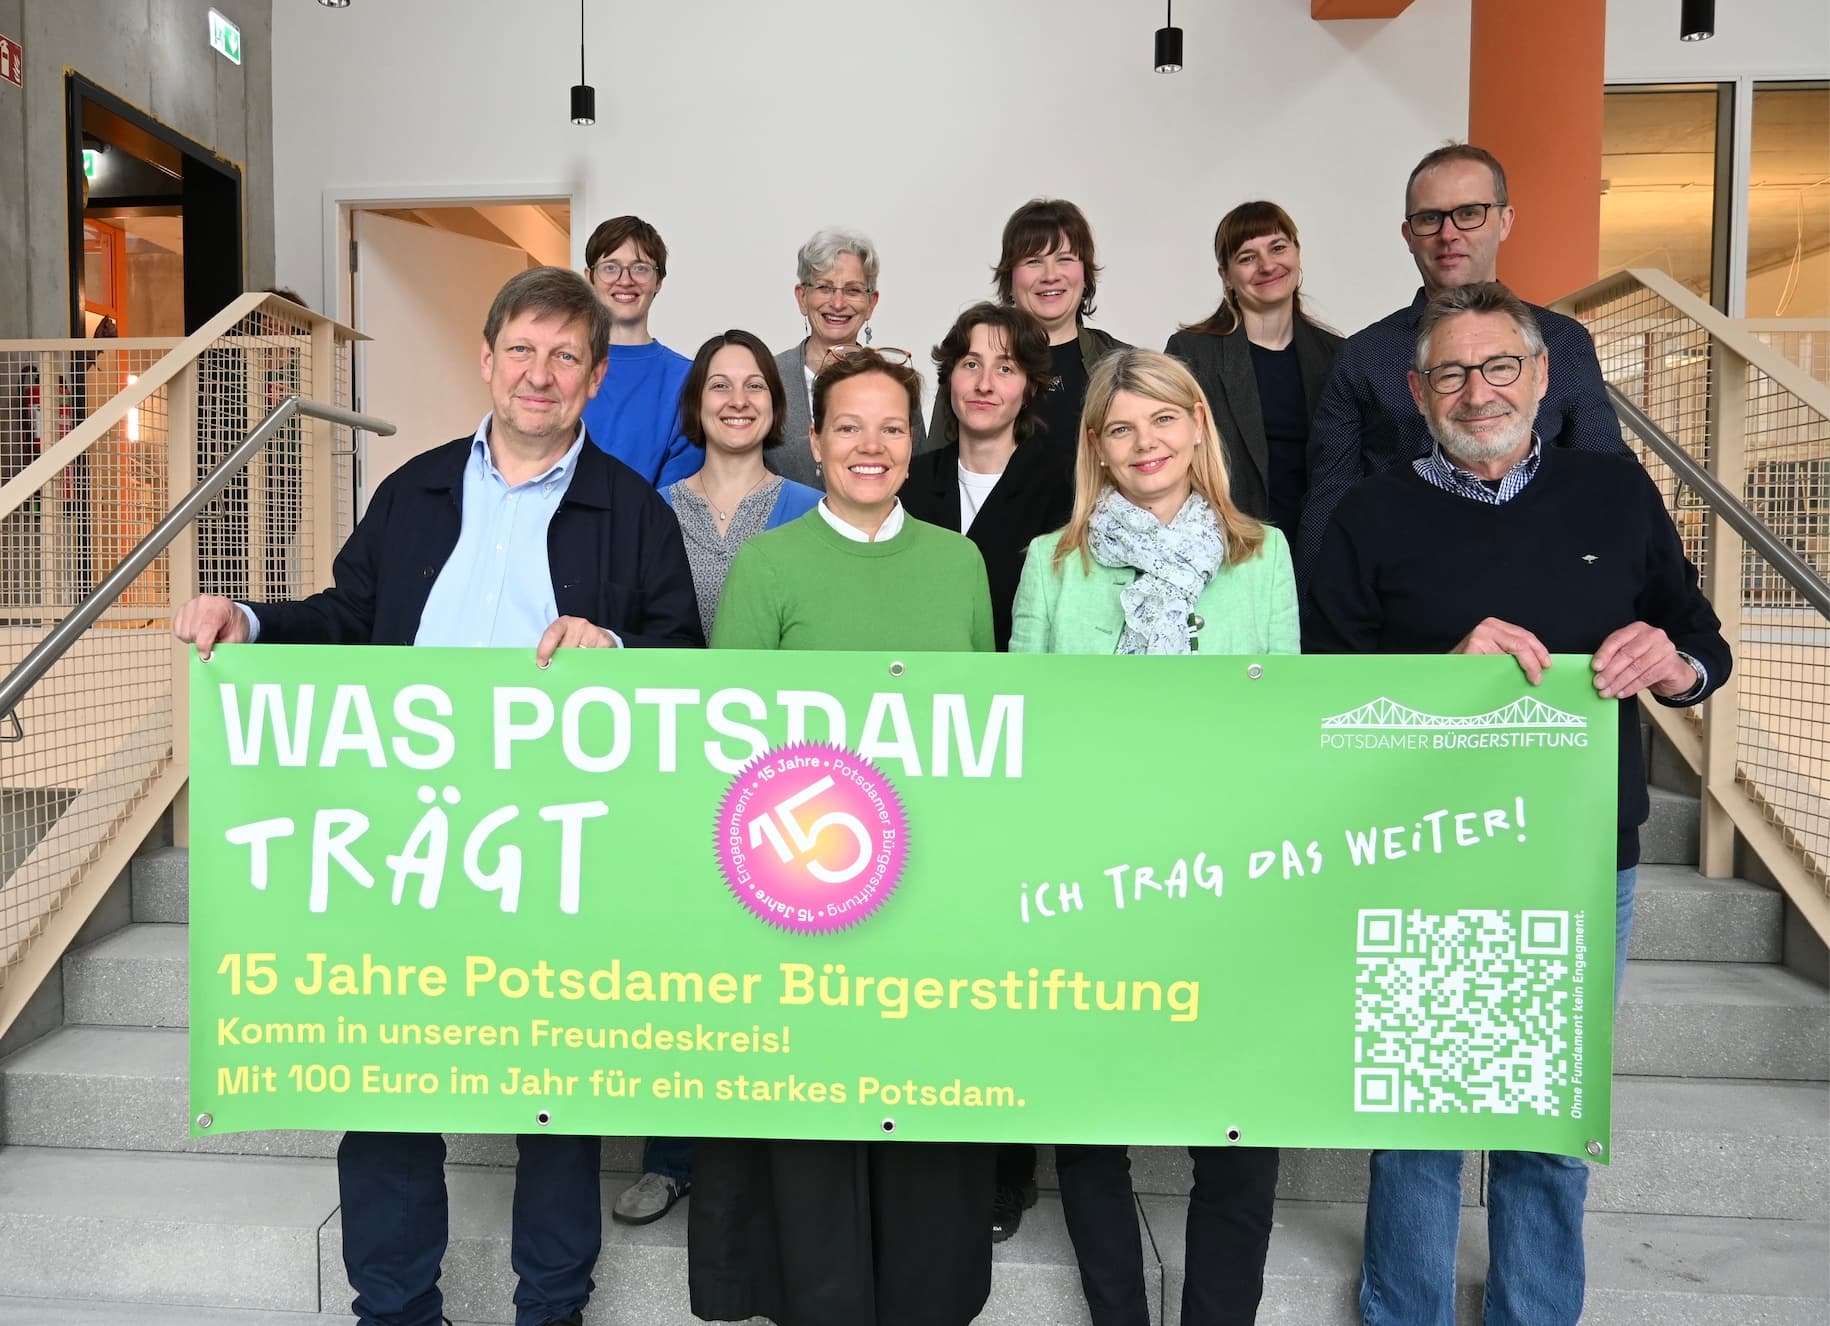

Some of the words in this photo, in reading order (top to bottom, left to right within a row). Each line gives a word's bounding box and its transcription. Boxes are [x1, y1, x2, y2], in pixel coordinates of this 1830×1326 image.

[220, 683, 456, 770] WAS
[493, 686, 1025, 778] POTSDAM
[777, 755, 820, 774] Jahre
[1320, 733, 1428, 750] POTSDAMER
[1433, 731, 1588, 749] BÜRGERSTIFTUNG
[757, 764, 776, 782] 15
[832, 758, 892, 826] Potsdamer
[225, 785, 609, 914] TRÄGT
[729, 786, 754, 885] Engagement
[748, 774, 873, 884] 15
[755, 889, 795, 919] Jahre
[826, 828, 896, 917] Bürgerstiftung
[1104, 852, 1224, 909] TRAG
[1249, 840, 1322, 880] DAS
[797, 908, 815, 922] 15
[1572, 910, 1587, 984] Engagment.
[217, 953, 278, 996] 15
[295, 952, 448, 998] Jahre
[466, 955, 763, 1005] Potsdamer
[779, 963, 1200, 1023] Bürgerstiftung
[1572, 985, 1584, 1012] kein
[217, 1017, 326, 1046] Komm
[338, 1016, 367, 1044] in
[379, 1024, 519, 1046] unseren
[531, 1019, 791, 1054] Freundeskreis!
[1571, 1015, 1584, 1084] Fundament
[217, 1065, 277, 1095] Mit
[288, 1064, 351, 1093] 100
[362, 1065, 439, 1094] Euro
[450, 1066, 489, 1095] im
[500, 1067, 579, 1097] Jahr
[589, 1068, 641, 1098] für
[652, 1070, 704, 1100] ein
[716, 1075, 847, 1104] starkes
[859, 1076, 1026, 1107] Potsdam.
[1570, 1087, 1583, 1120] Ohne
